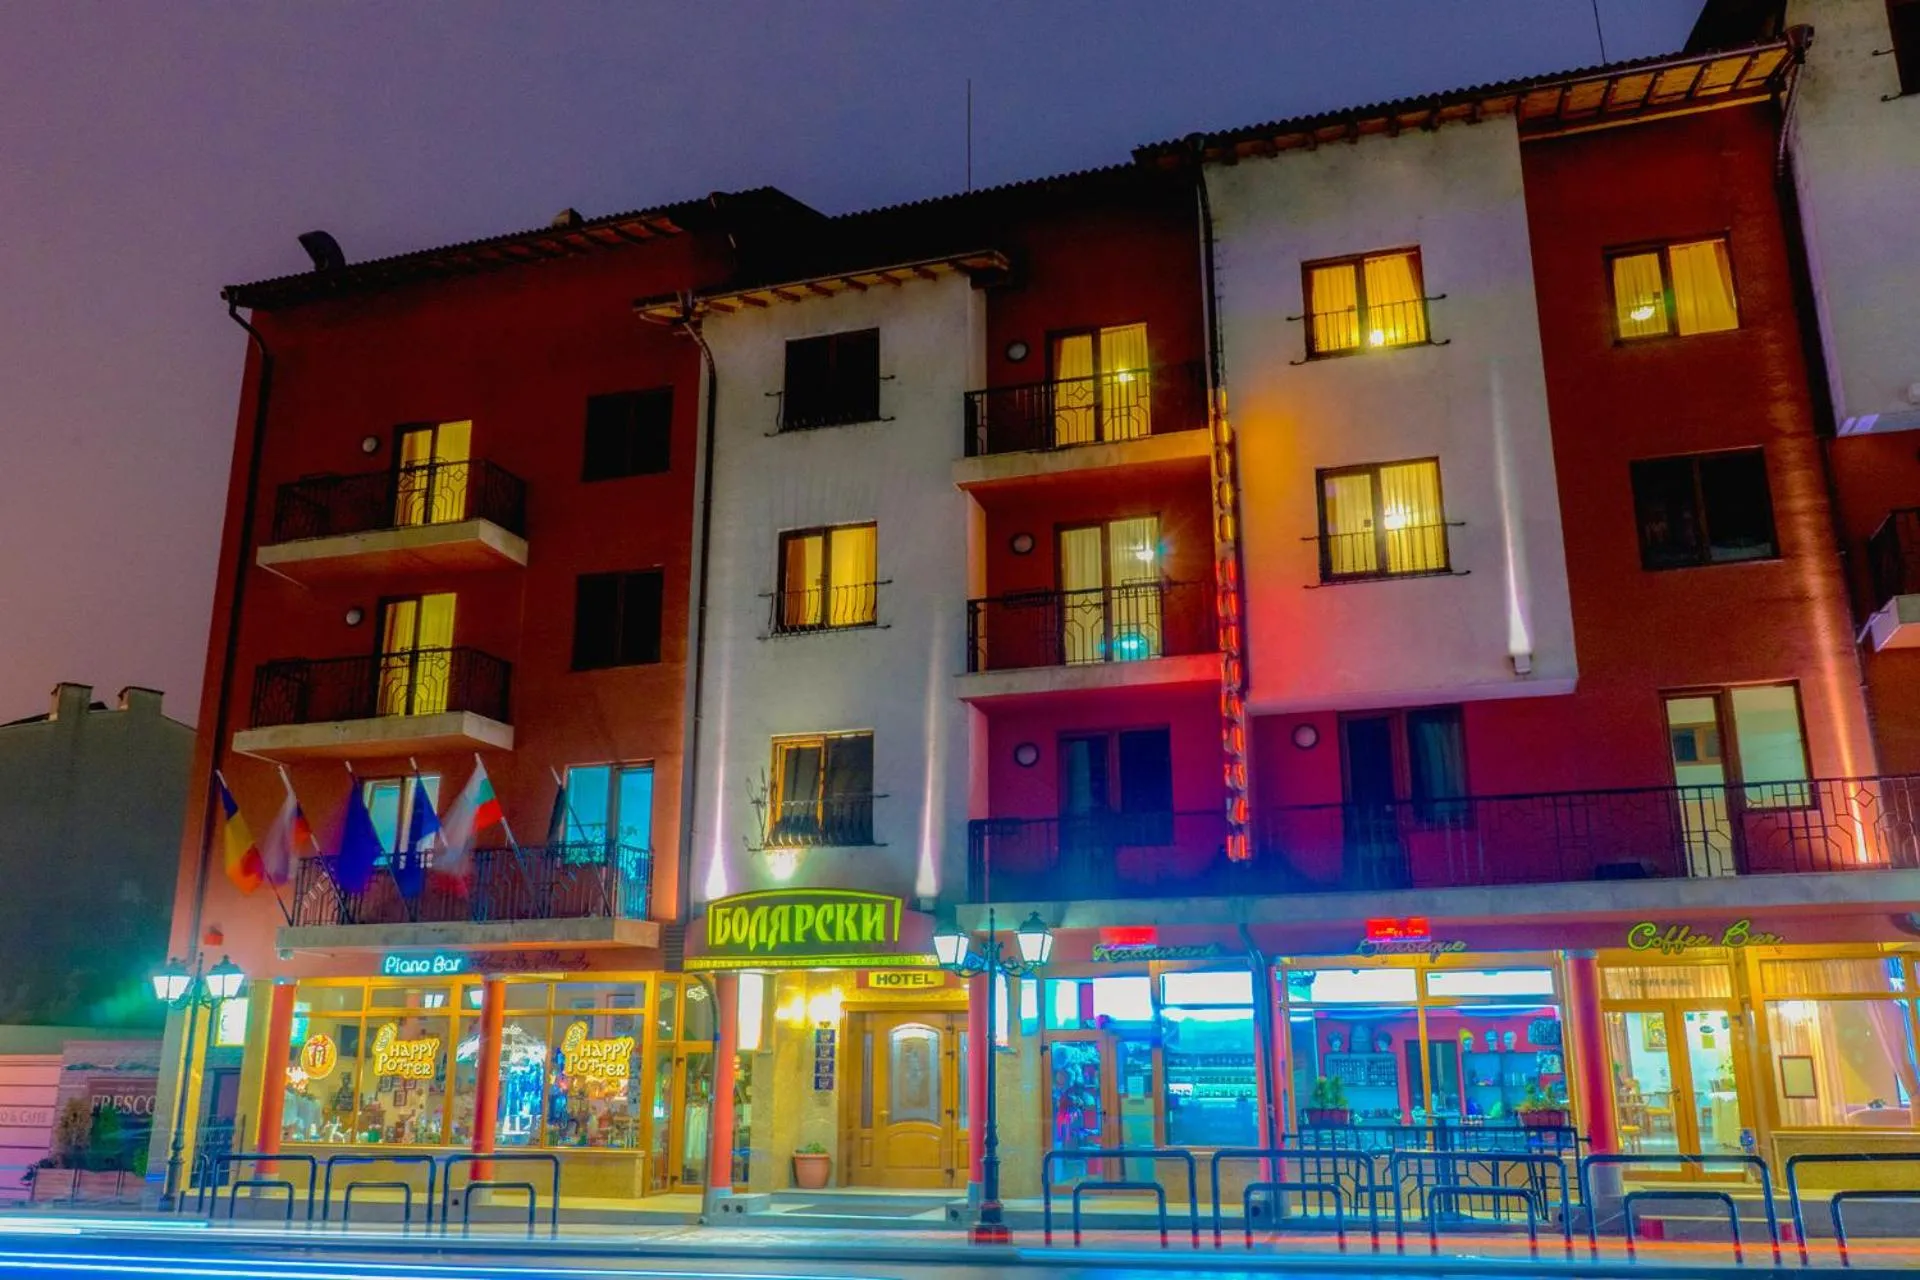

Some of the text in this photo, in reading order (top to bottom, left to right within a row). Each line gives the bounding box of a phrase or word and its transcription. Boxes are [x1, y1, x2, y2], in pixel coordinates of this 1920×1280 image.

[714, 903, 886, 951] БОЛЯРСКИ
[1628, 919, 1784, 954] Coffee Bar
[384, 956, 429, 973] Piano
[432, 955, 462, 973] Bar
[876, 973, 935, 986] HOTEL
[390, 1041, 438, 1061] HAPPY
[580, 1040, 631, 1061] HAPPY
[378, 1053, 432, 1075] POTTER
[568, 1054, 626, 1076] POTTER
[91, 1094, 156, 1116] FRESCO
